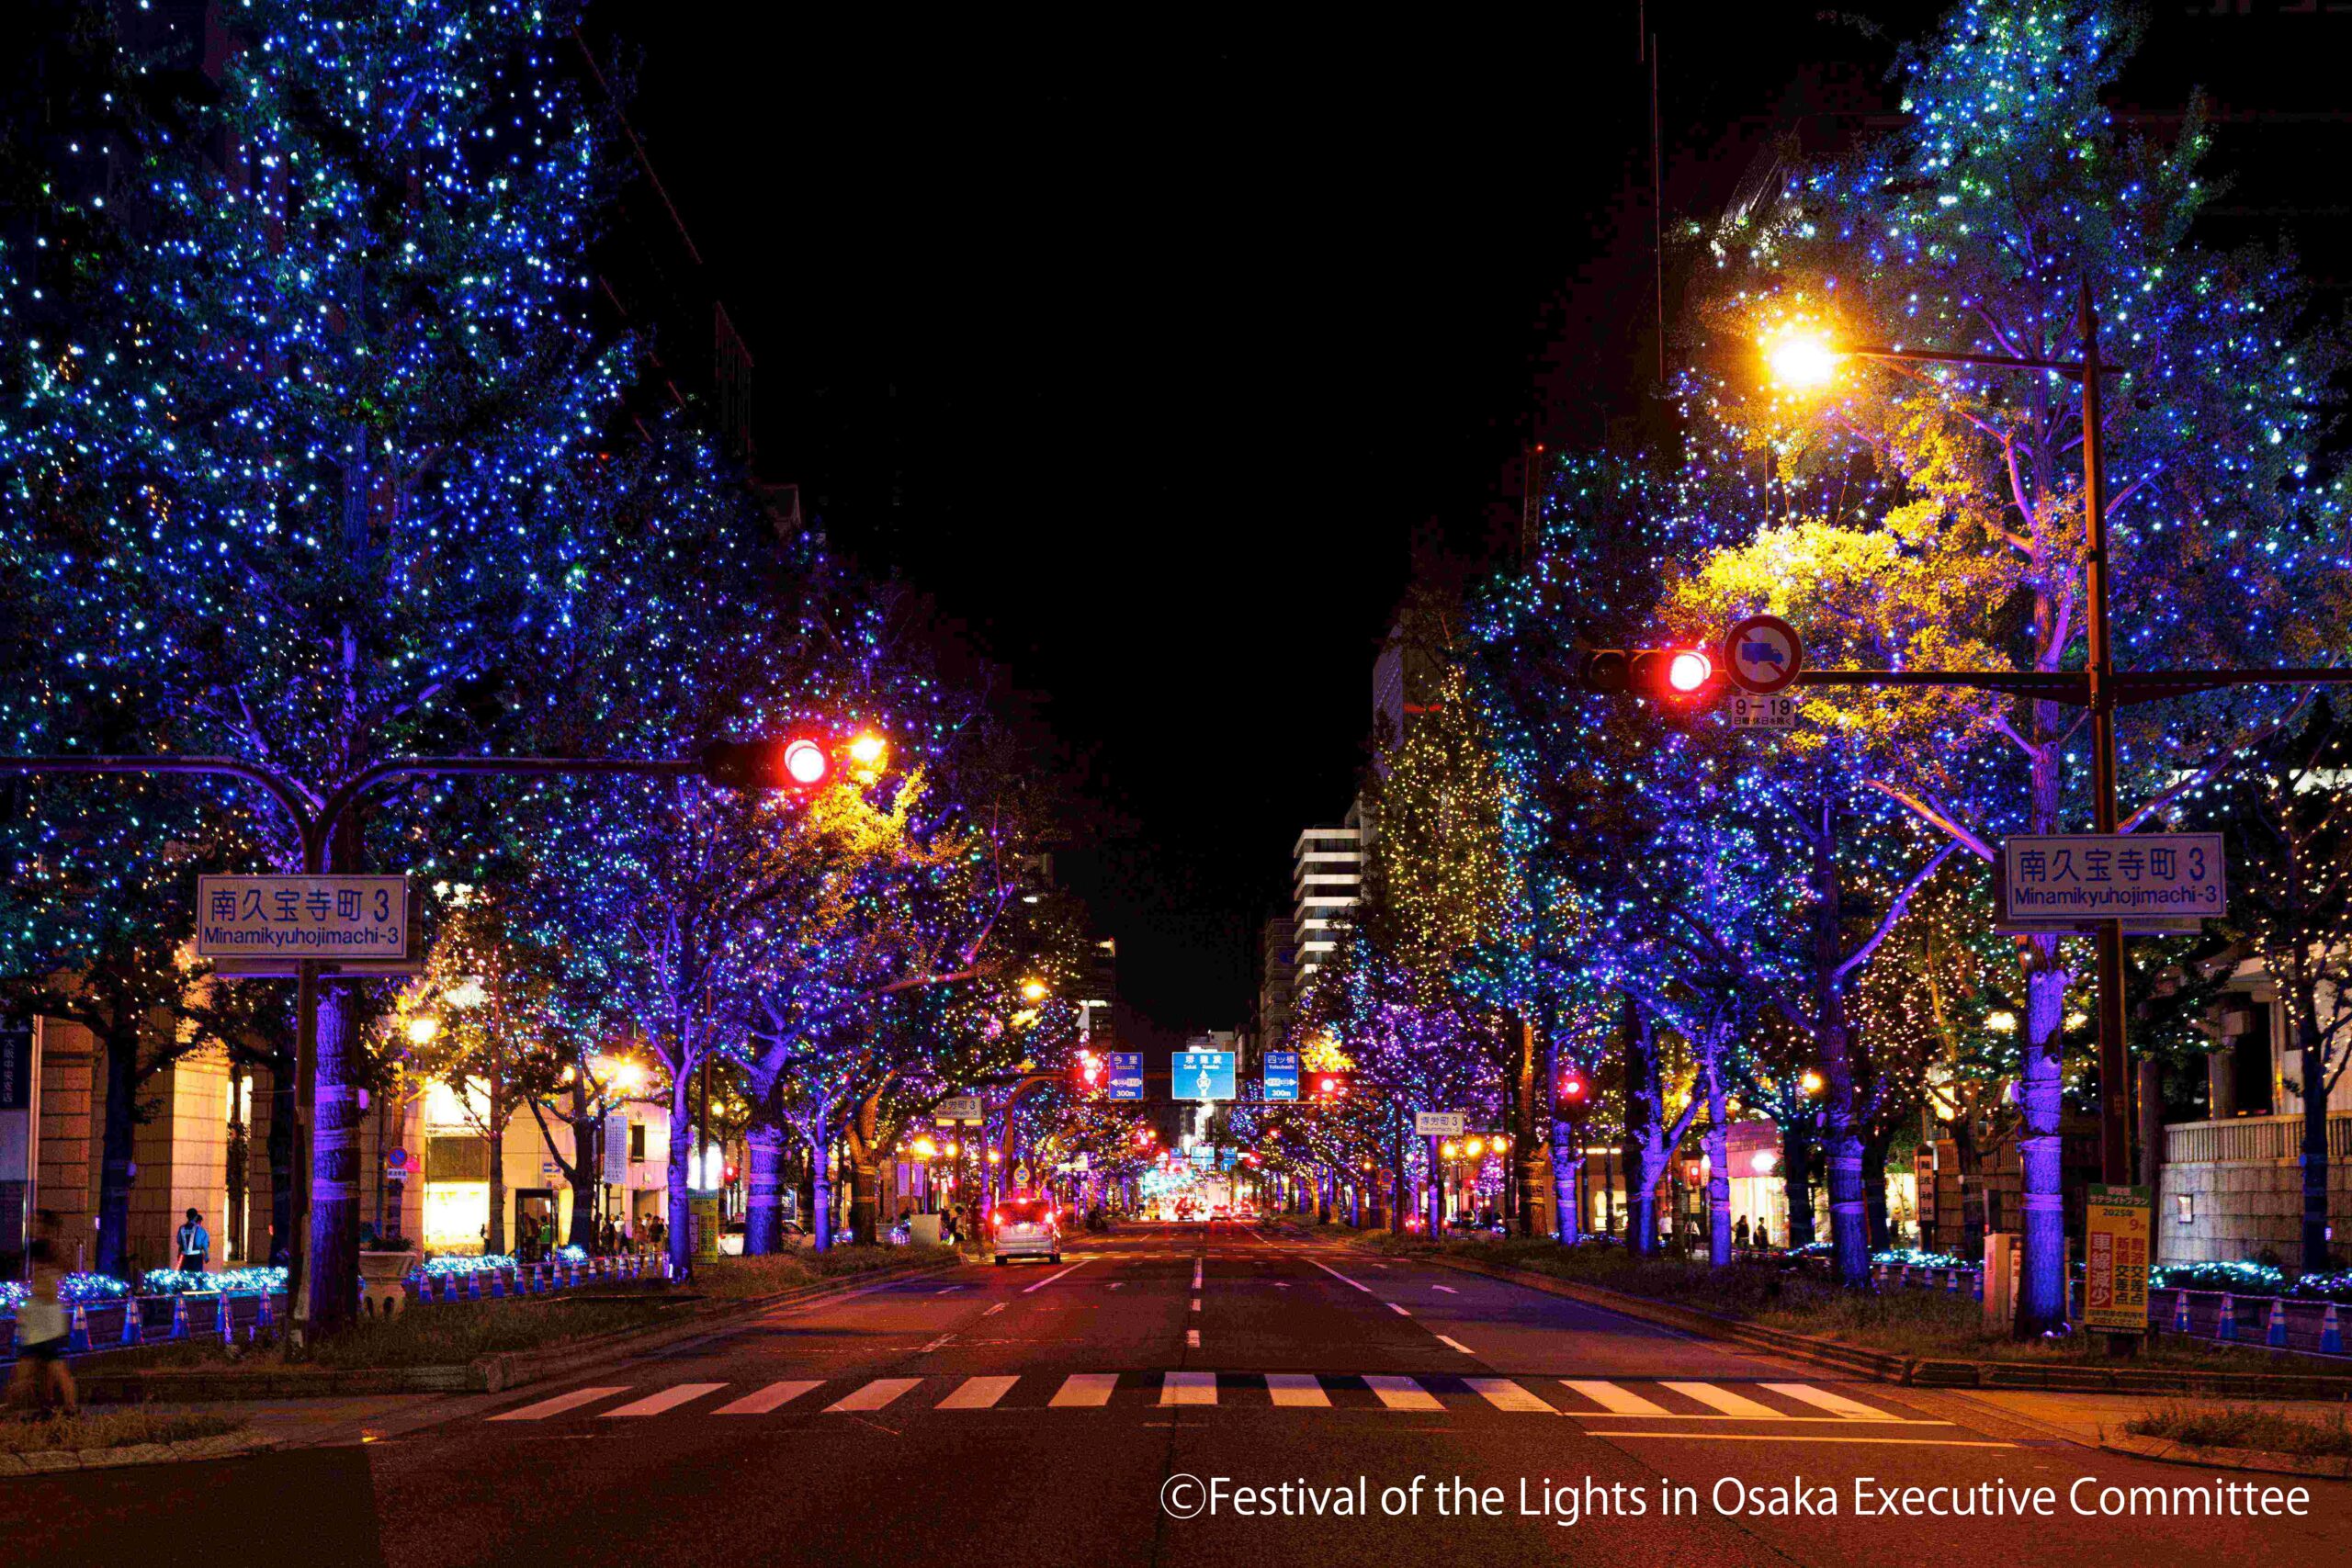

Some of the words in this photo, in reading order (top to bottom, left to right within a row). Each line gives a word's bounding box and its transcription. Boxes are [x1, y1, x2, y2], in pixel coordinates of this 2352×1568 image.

[2019, 847, 2177, 883] 南久宝寺町
[2188, 847, 2205, 881] 3
[210, 888, 363, 922] 南久宝寺町
[373, 888, 390, 923] 3
[2015, 885, 2217, 908] Minamikyuhojimachi-3
[203, 926, 399, 947] Minamikyuhojimachi-3
[1268, 1055, 1295, 1064] 四ツ橋
[1452, 1116, 1458, 1126] 3
[2091, 1234, 2111, 1306] 車線減少
